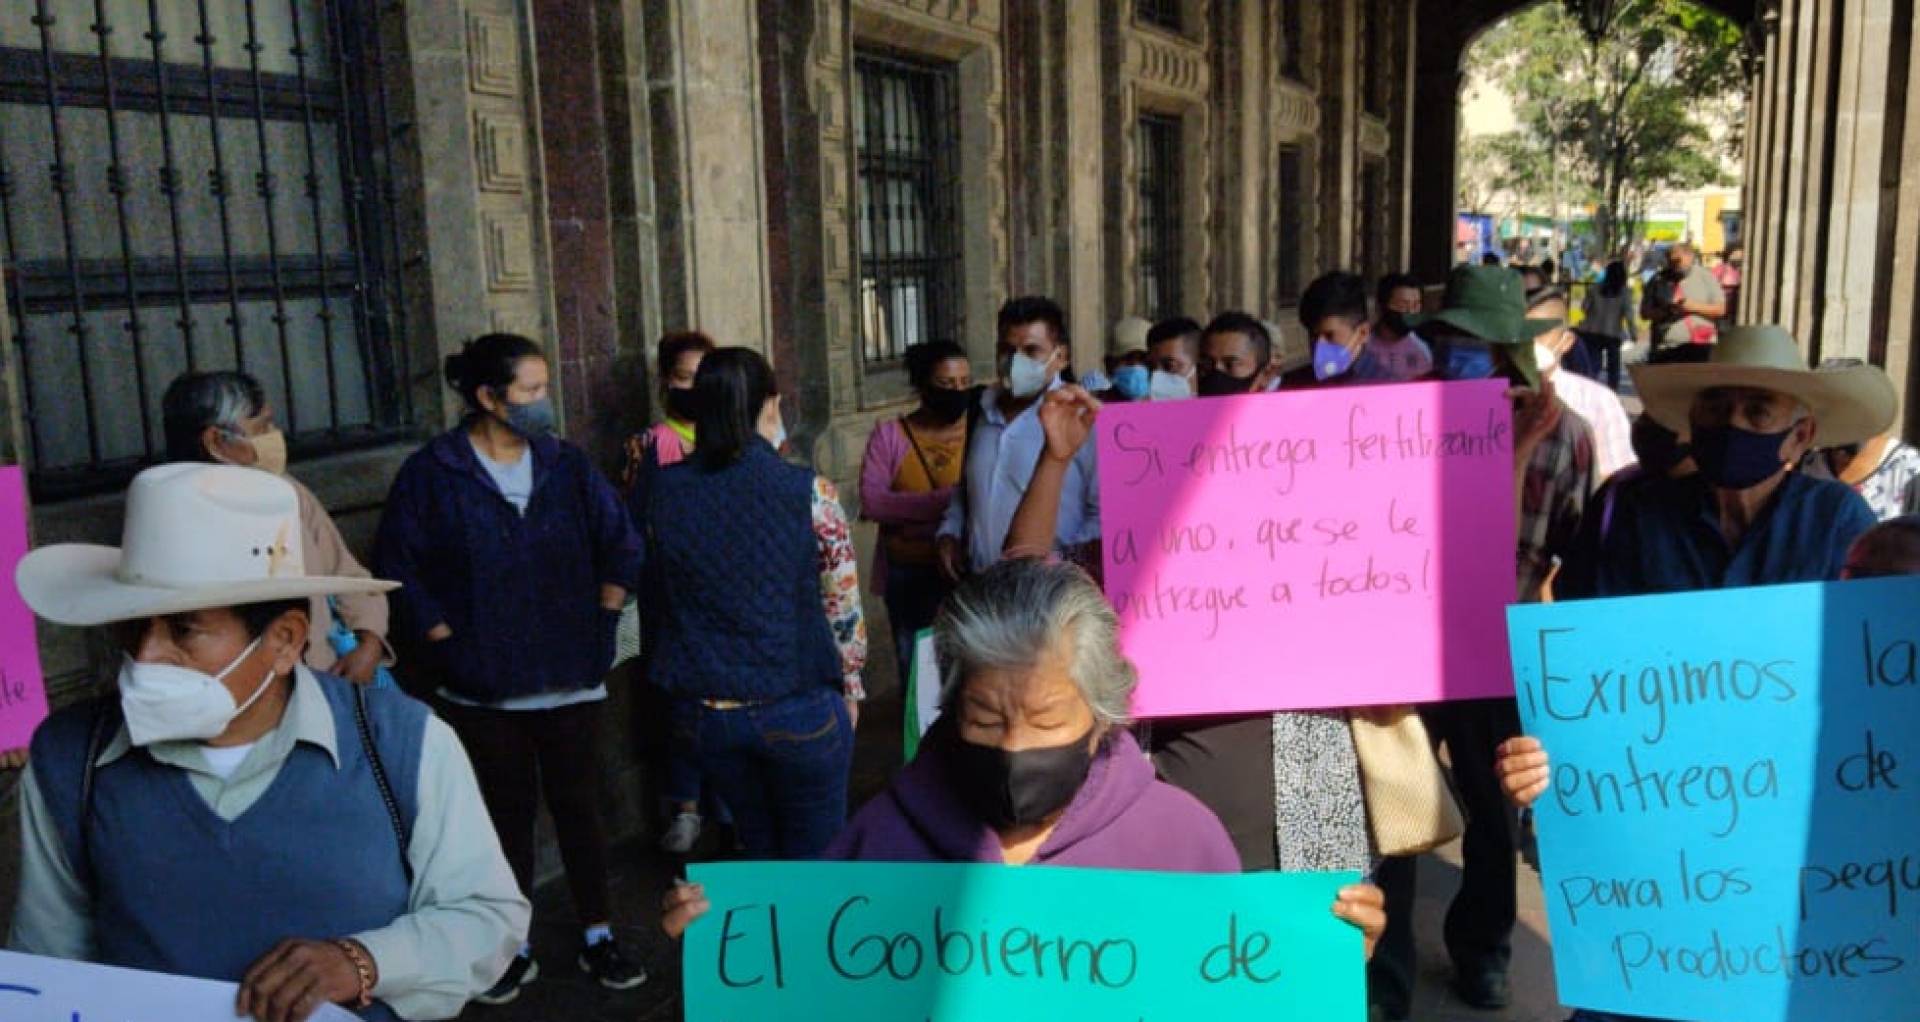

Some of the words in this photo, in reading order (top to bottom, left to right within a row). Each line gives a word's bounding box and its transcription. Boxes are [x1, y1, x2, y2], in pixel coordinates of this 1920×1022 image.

[1113, 422, 1164, 486] Si
[1181, 423, 1317, 495] entrega
[1342, 403, 1508, 472] fertilizante
[1111, 527, 1138, 566] a
[1256, 517, 1302, 561] que
[1312, 517, 1359, 546] se
[1270, 581, 1293, 605] a
[1311, 548, 1433, 601] todos!
[1862, 618, 1918, 688] la
[1554, 745, 1779, 838] entrega
[1835, 729, 1900, 792] de
[1559, 872, 1663, 927] para
[1680, 847, 1753, 903] los
[718, 904, 785, 990] El
[827, 895, 1138, 989] Gobierno
[1199, 911, 1282, 984] de
